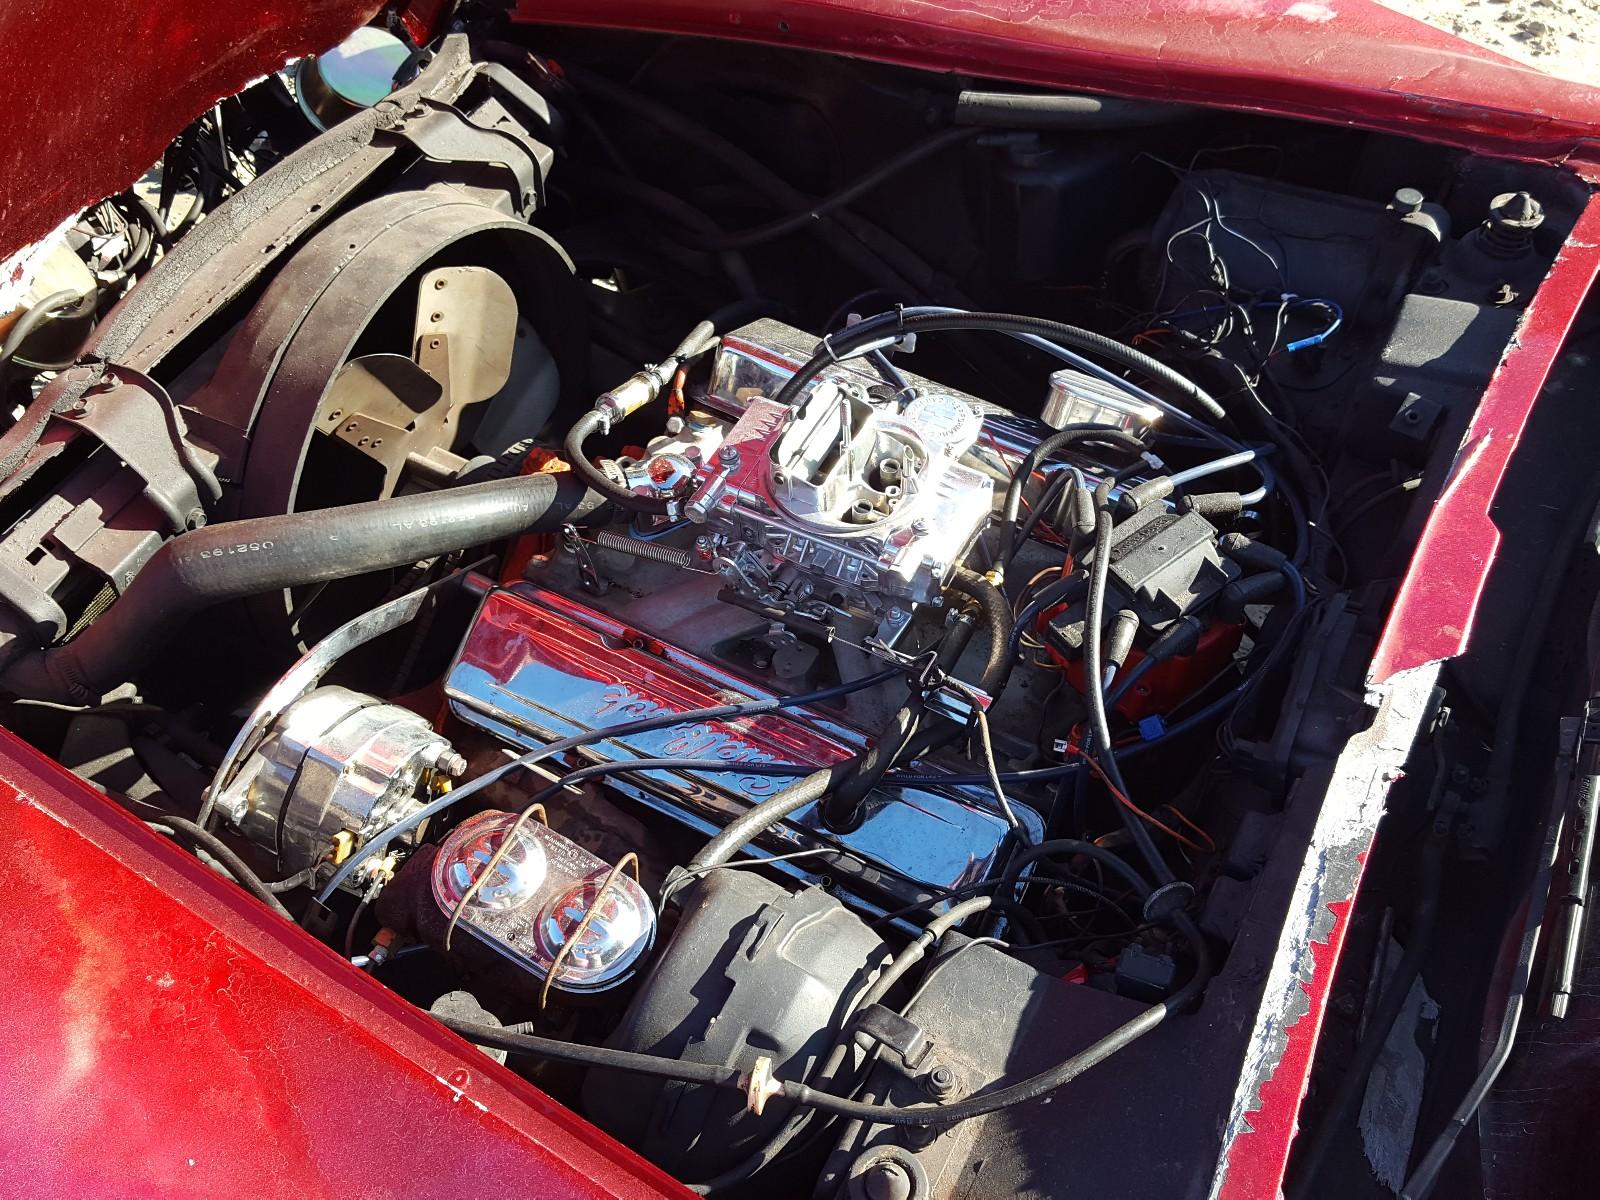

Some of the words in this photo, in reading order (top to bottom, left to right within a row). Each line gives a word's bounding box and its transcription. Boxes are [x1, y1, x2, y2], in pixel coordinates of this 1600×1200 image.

[390, 518, 414, 531] AL
[199, 539, 274, 559] 052193
[594, 683, 797, 797] Edelbock
[543, 832, 571, 852] WARNING
[578, 854, 599, 869] CLEAN
[517, 933, 536, 948] FROM
